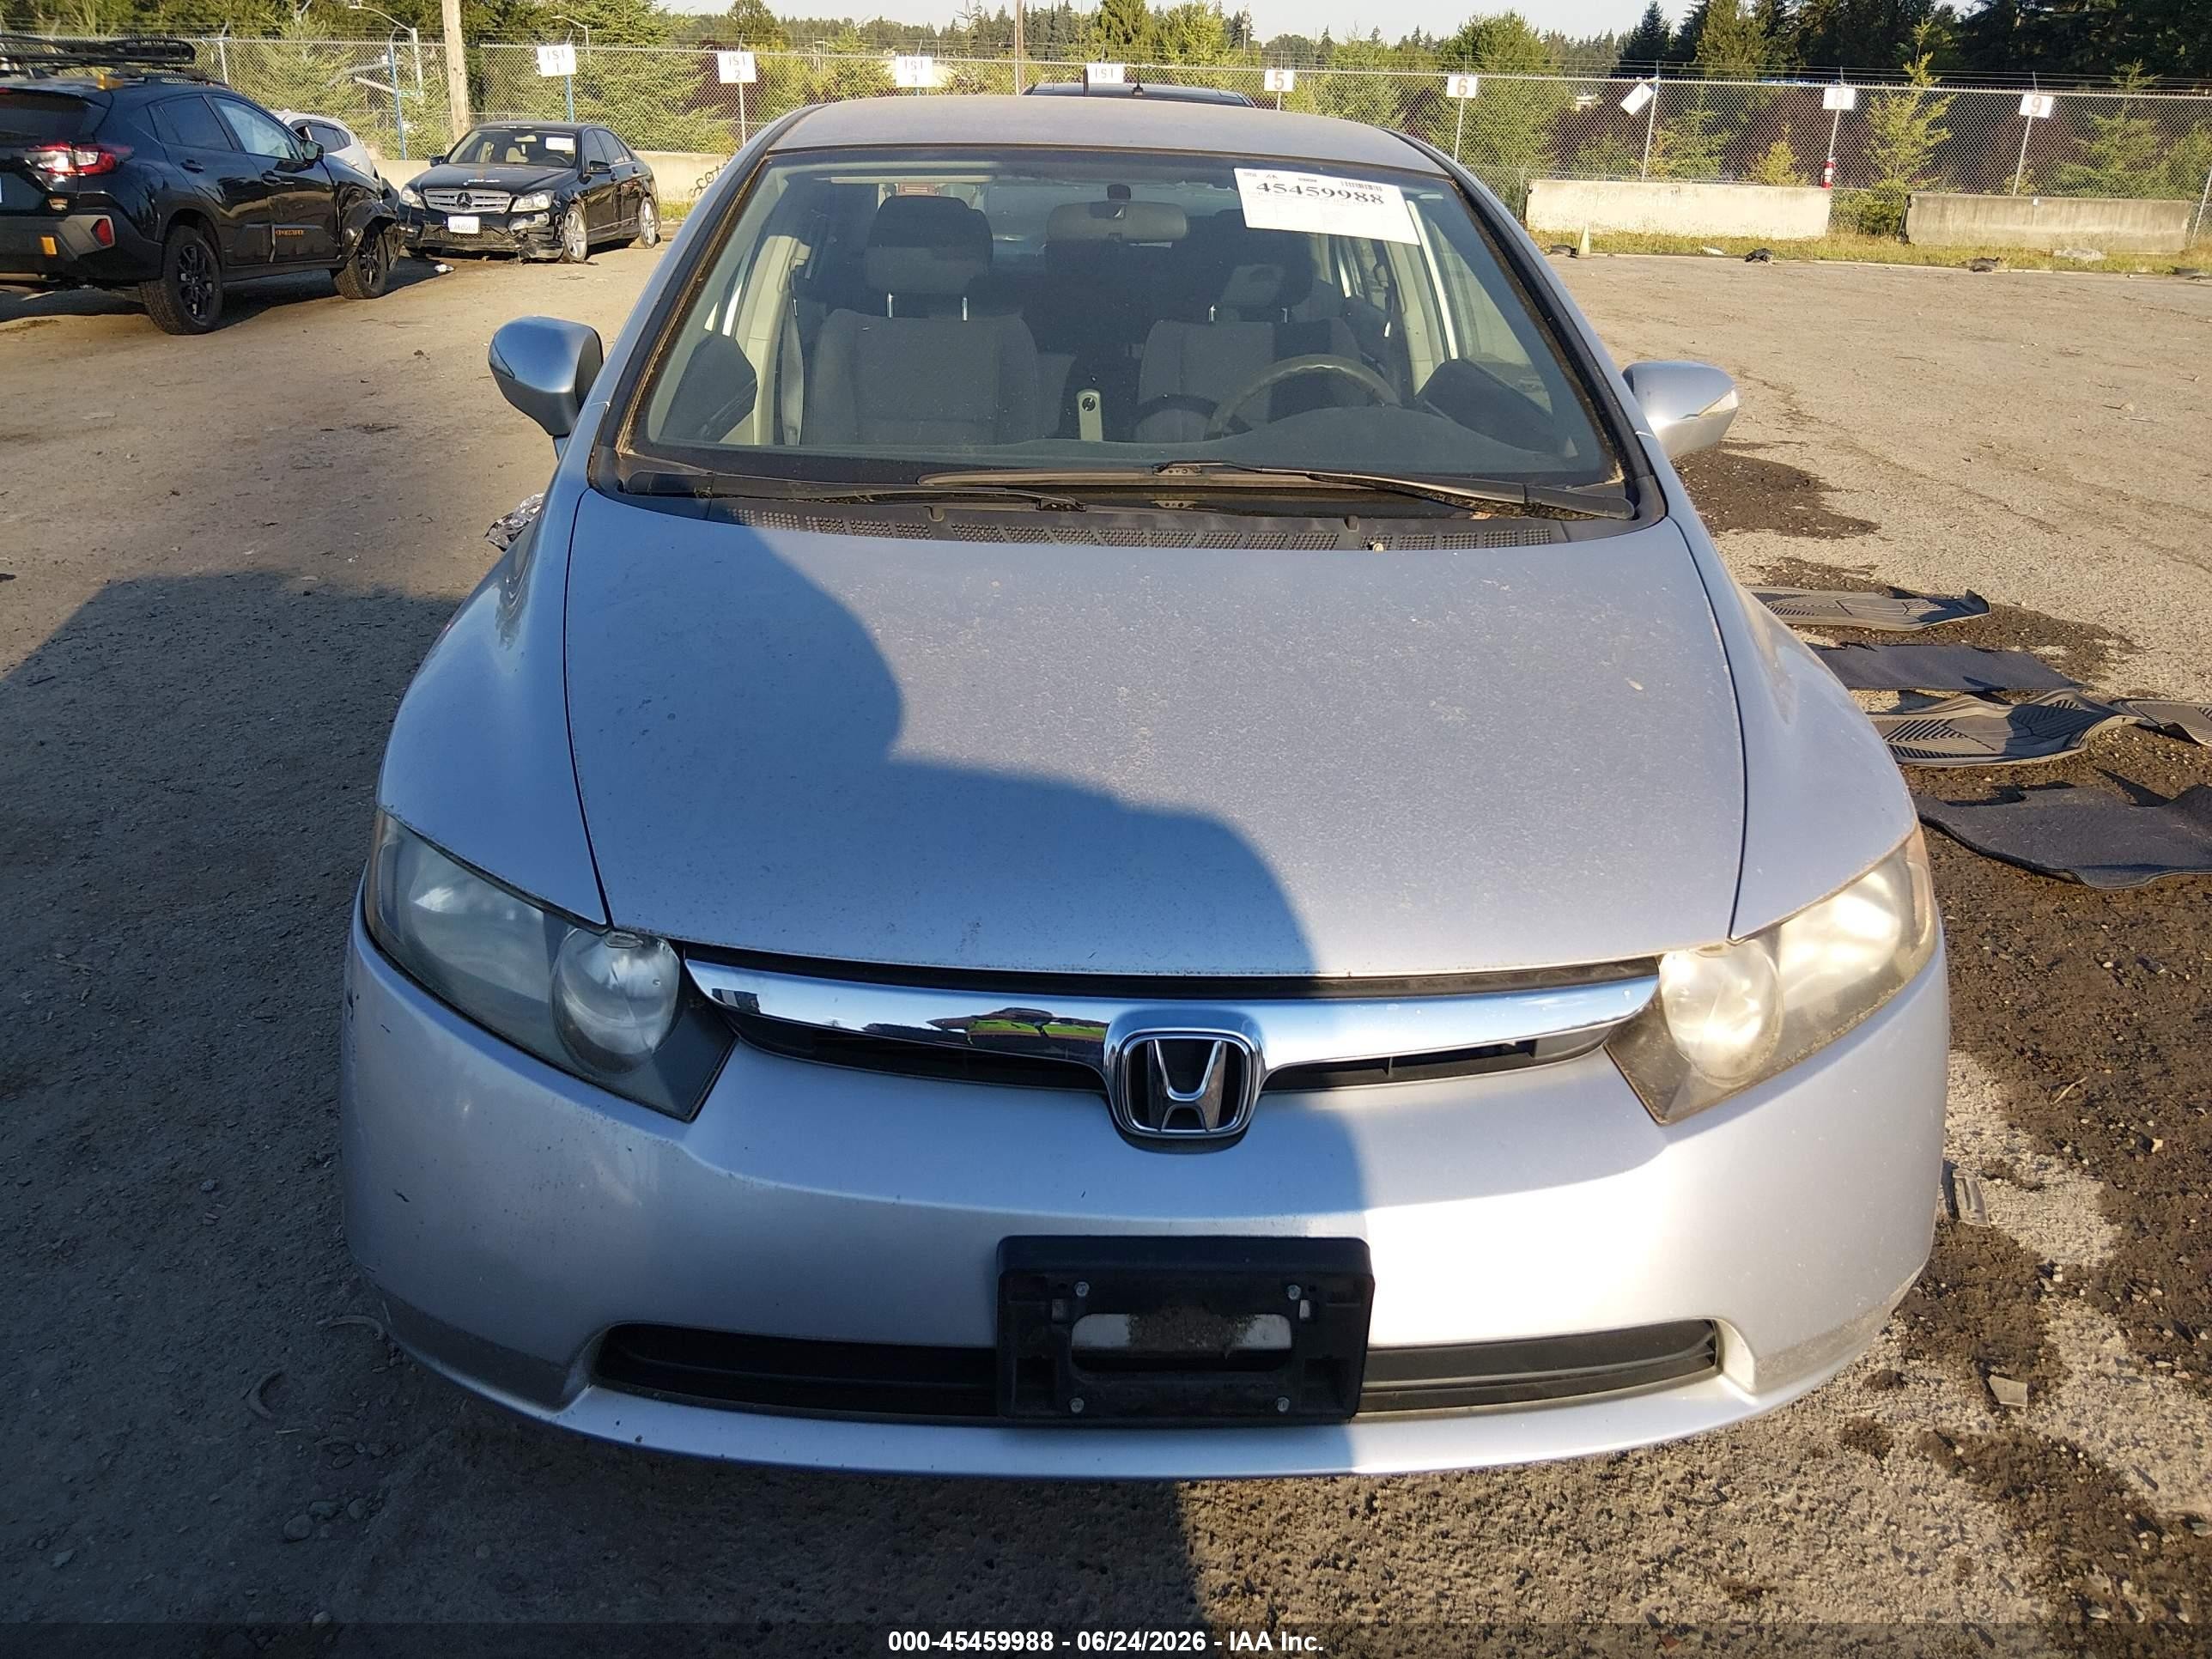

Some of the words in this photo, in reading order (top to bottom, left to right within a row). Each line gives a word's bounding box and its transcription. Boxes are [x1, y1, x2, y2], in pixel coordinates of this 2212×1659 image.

[1274, 71, 1285, 90] 5
[1457, 77, 1468, 96] 6
[1833, 88, 1844, 108] 8
[2030, 96, 2043, 115] 9
[1256, 181, 1385, 205] 45459988
